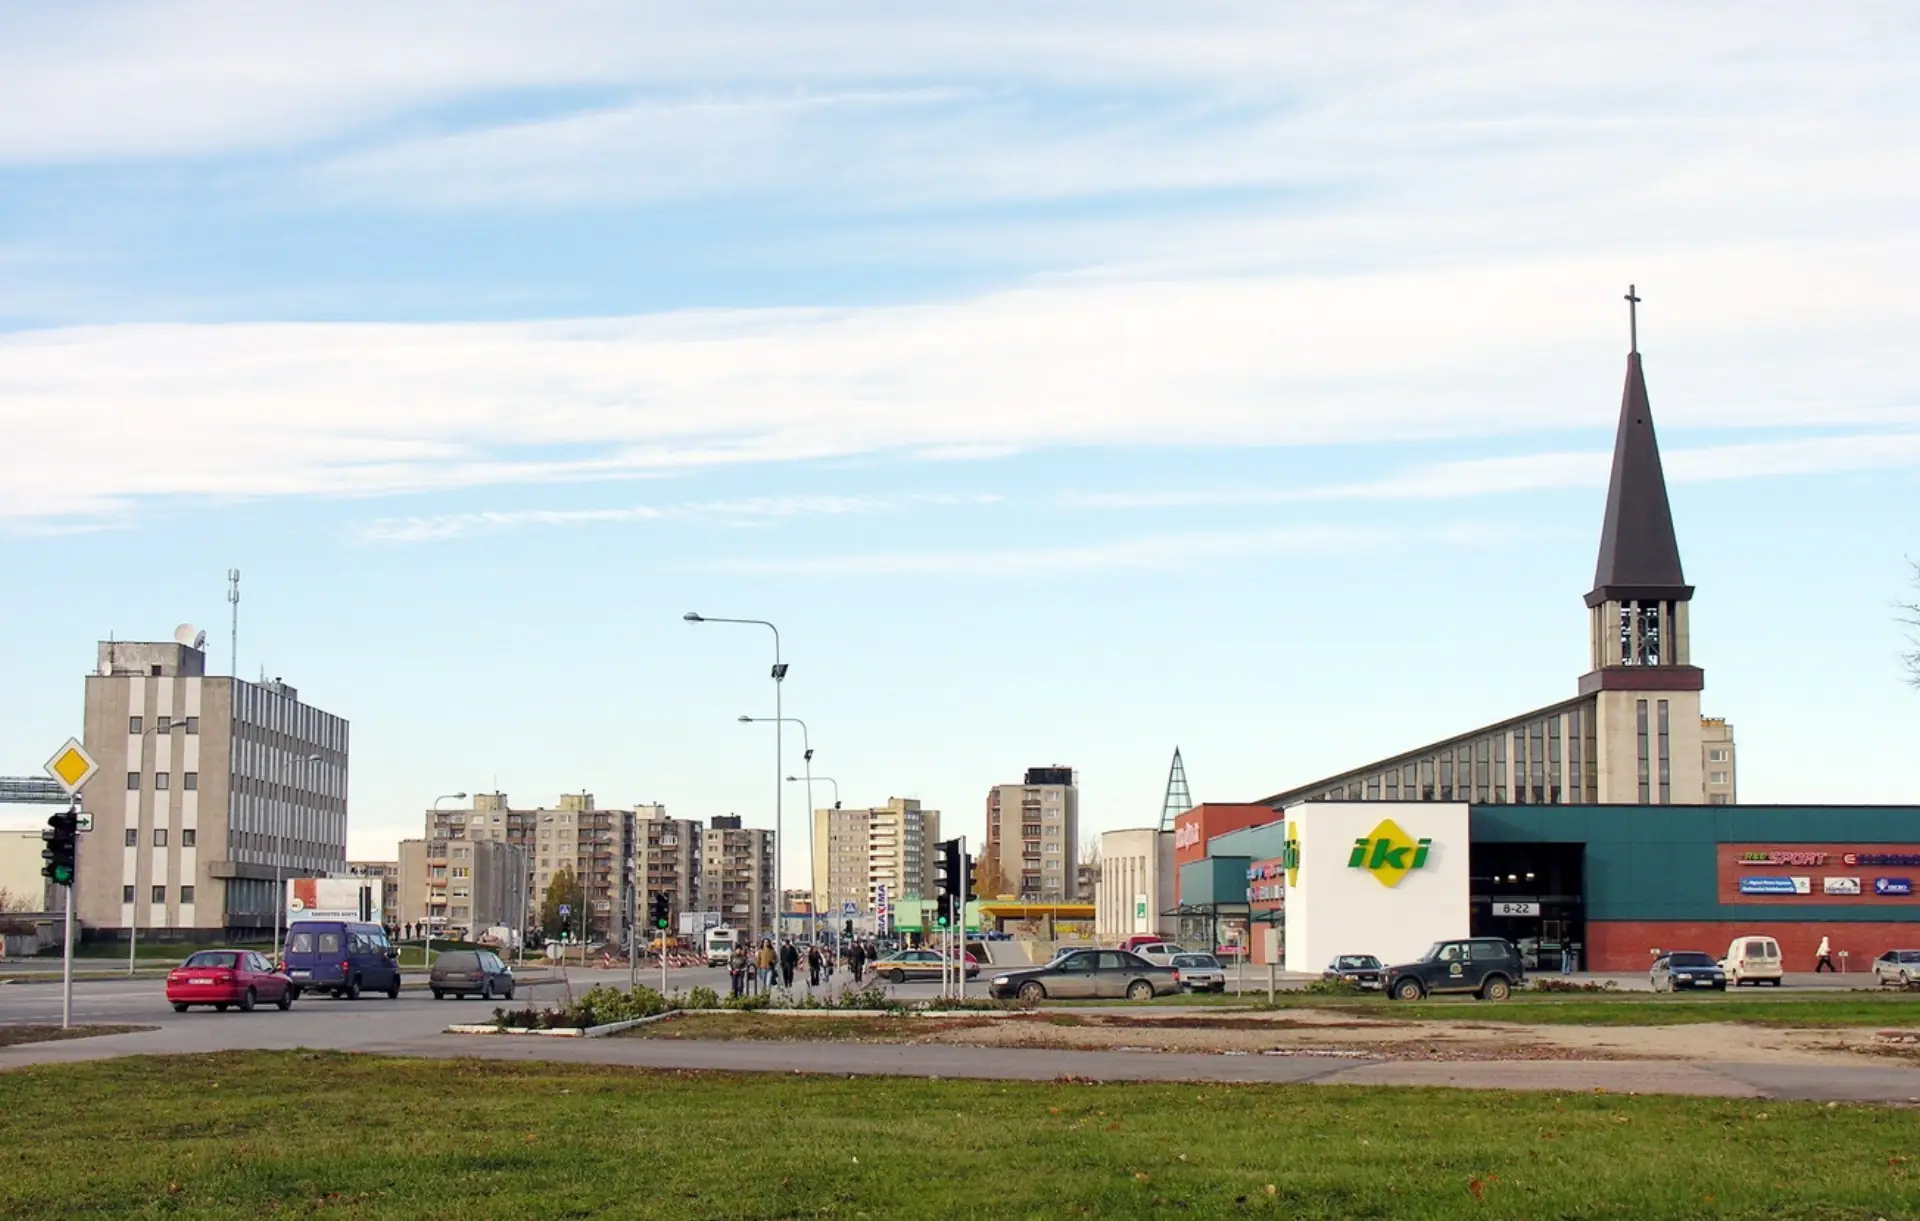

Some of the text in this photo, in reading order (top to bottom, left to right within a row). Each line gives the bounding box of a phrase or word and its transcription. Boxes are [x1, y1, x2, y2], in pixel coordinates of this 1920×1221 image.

[1347, 838, 1432, 870] iki
[1769, 851, 1828, 866] SPORT
[877, 883, 886, 932] MAXIMA
[1503, 904, 1529, 914] 8-22
